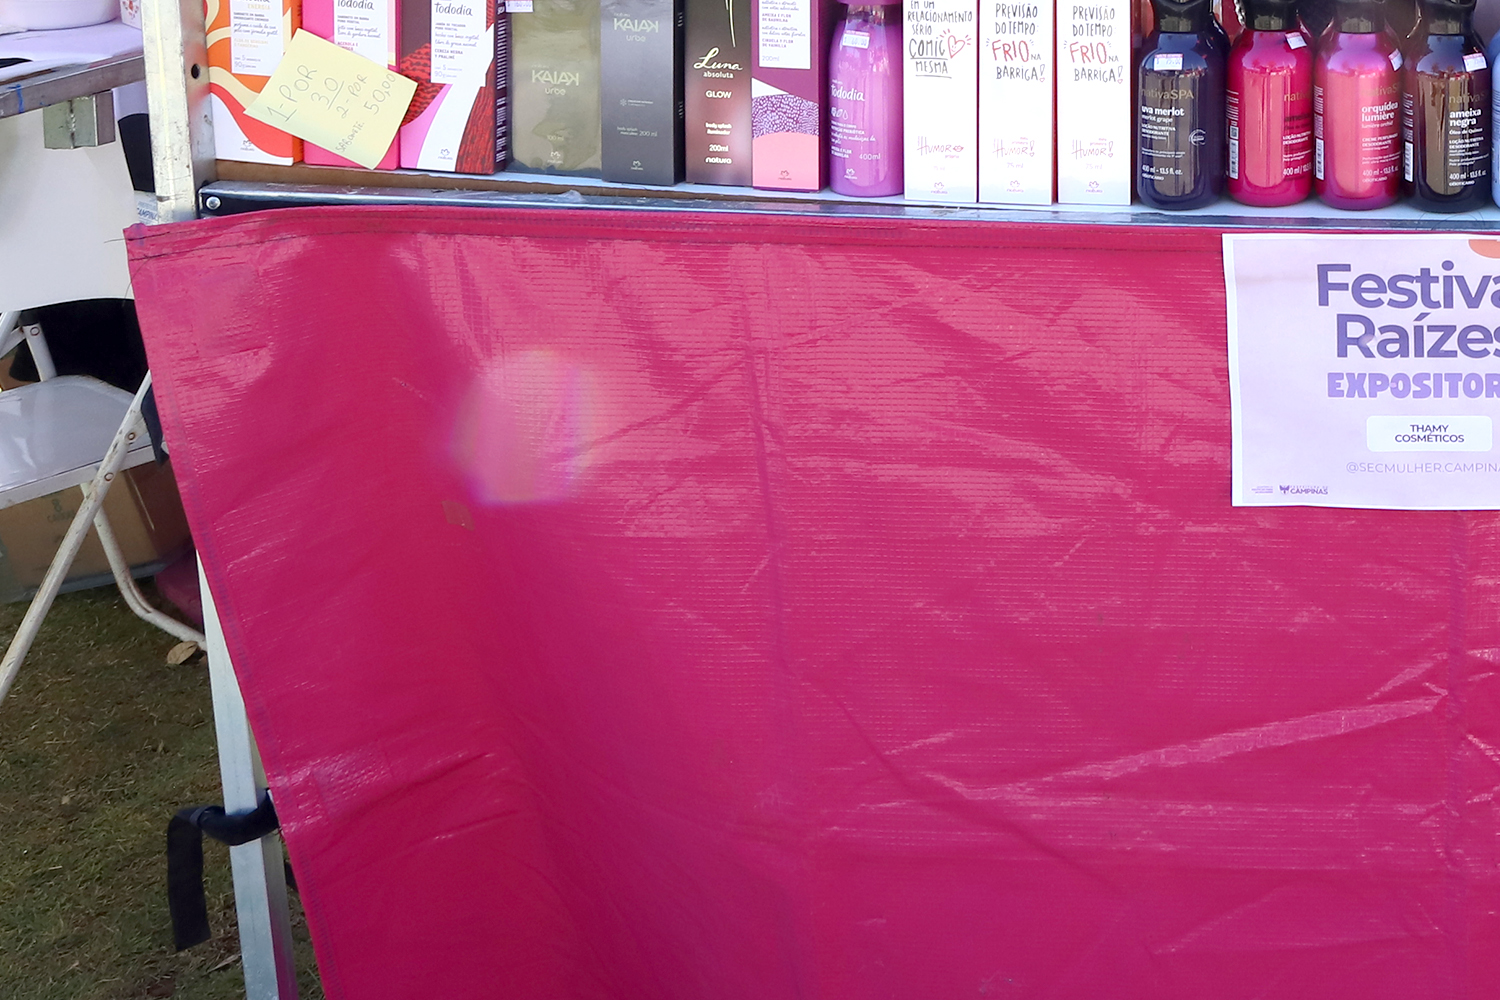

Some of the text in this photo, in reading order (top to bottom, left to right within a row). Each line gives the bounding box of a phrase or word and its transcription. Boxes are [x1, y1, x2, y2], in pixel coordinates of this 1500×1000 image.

[434, 2, 473, 16] tododia
[910, 0, 935, 10] EM UM
[995, 2, 1038, 19] PREVISÃO
[907, 10, 973, 23] RELACIONAMENTO
[1072, 4, 1116, 21] PREVISÃO
[613, 18, 659, 33] KAIAK
[912, 23, 932, 36] SÉRIO
[992, 40, 1042, 63] FRIO NA
[1069, 42, 1107, 64] FRIO
[693, 47, 743, 71] Luna
[915, 61, 949, 75] MESMA
[531, 70, 579, 86] KAIAK
[703, 71, 734, 79] absoluta
[705, 90, 732, 99] GLOW
[831, 84, 865, 101] tododia
[1141, 106, 1185, 117] uva merlot
[1361, 101, 1399, 115] orquídea
[1449, 108, 1482, 118] ameixa
[1156, 116, 1173, 124] grape
[1361, 110, 1395, 122] lumière
[1449, 117, 1477, 129] negra
[709, 144, 729, 152] 200ml
[859, 153, 881, 161] 400ml
[1410, 424, 1449, 433] THAMY
[1395, 432, 1464, 443] COSMÉTICOS
